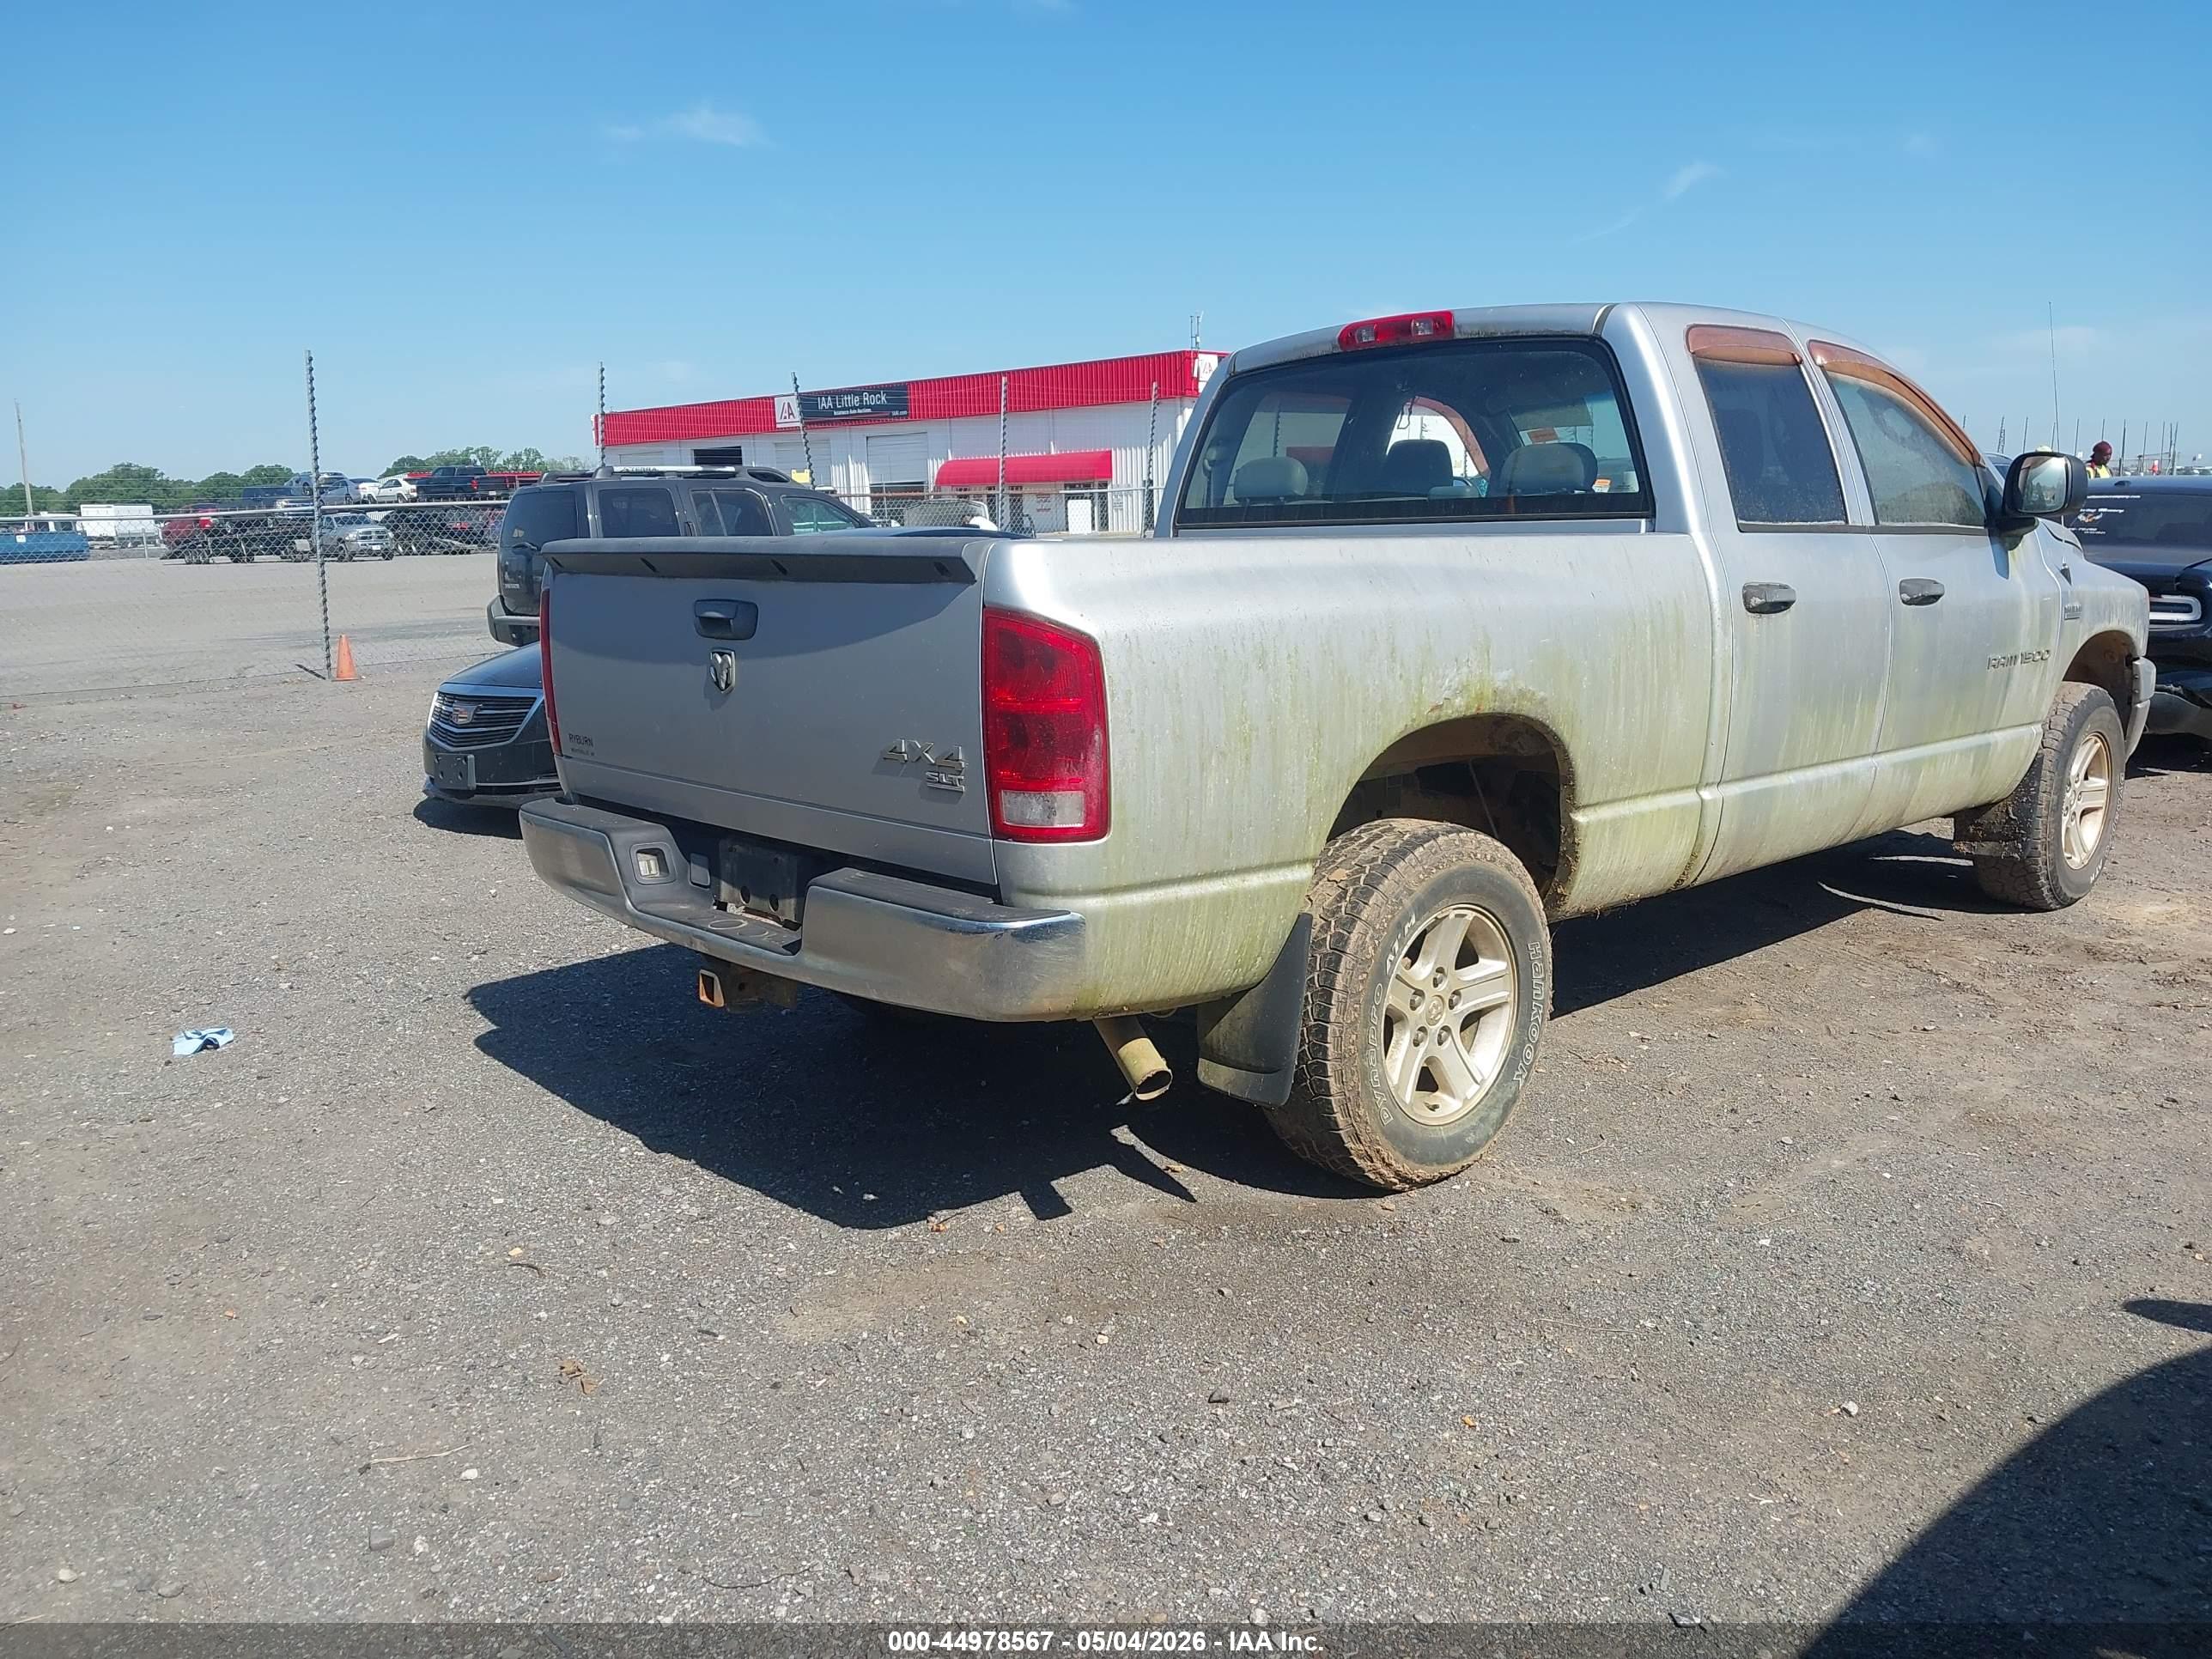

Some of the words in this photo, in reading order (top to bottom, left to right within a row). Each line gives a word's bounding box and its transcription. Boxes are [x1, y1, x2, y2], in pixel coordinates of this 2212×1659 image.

[817, 396, 833, 410] IAA
[836, 393, 860, 409] Little
[863, 390, 887, 405] Rock
[1986, 653, 2018, 670] RAM
[2020, 649, 2051, 665] 1500
[926, 770, 964, 787] SLT
